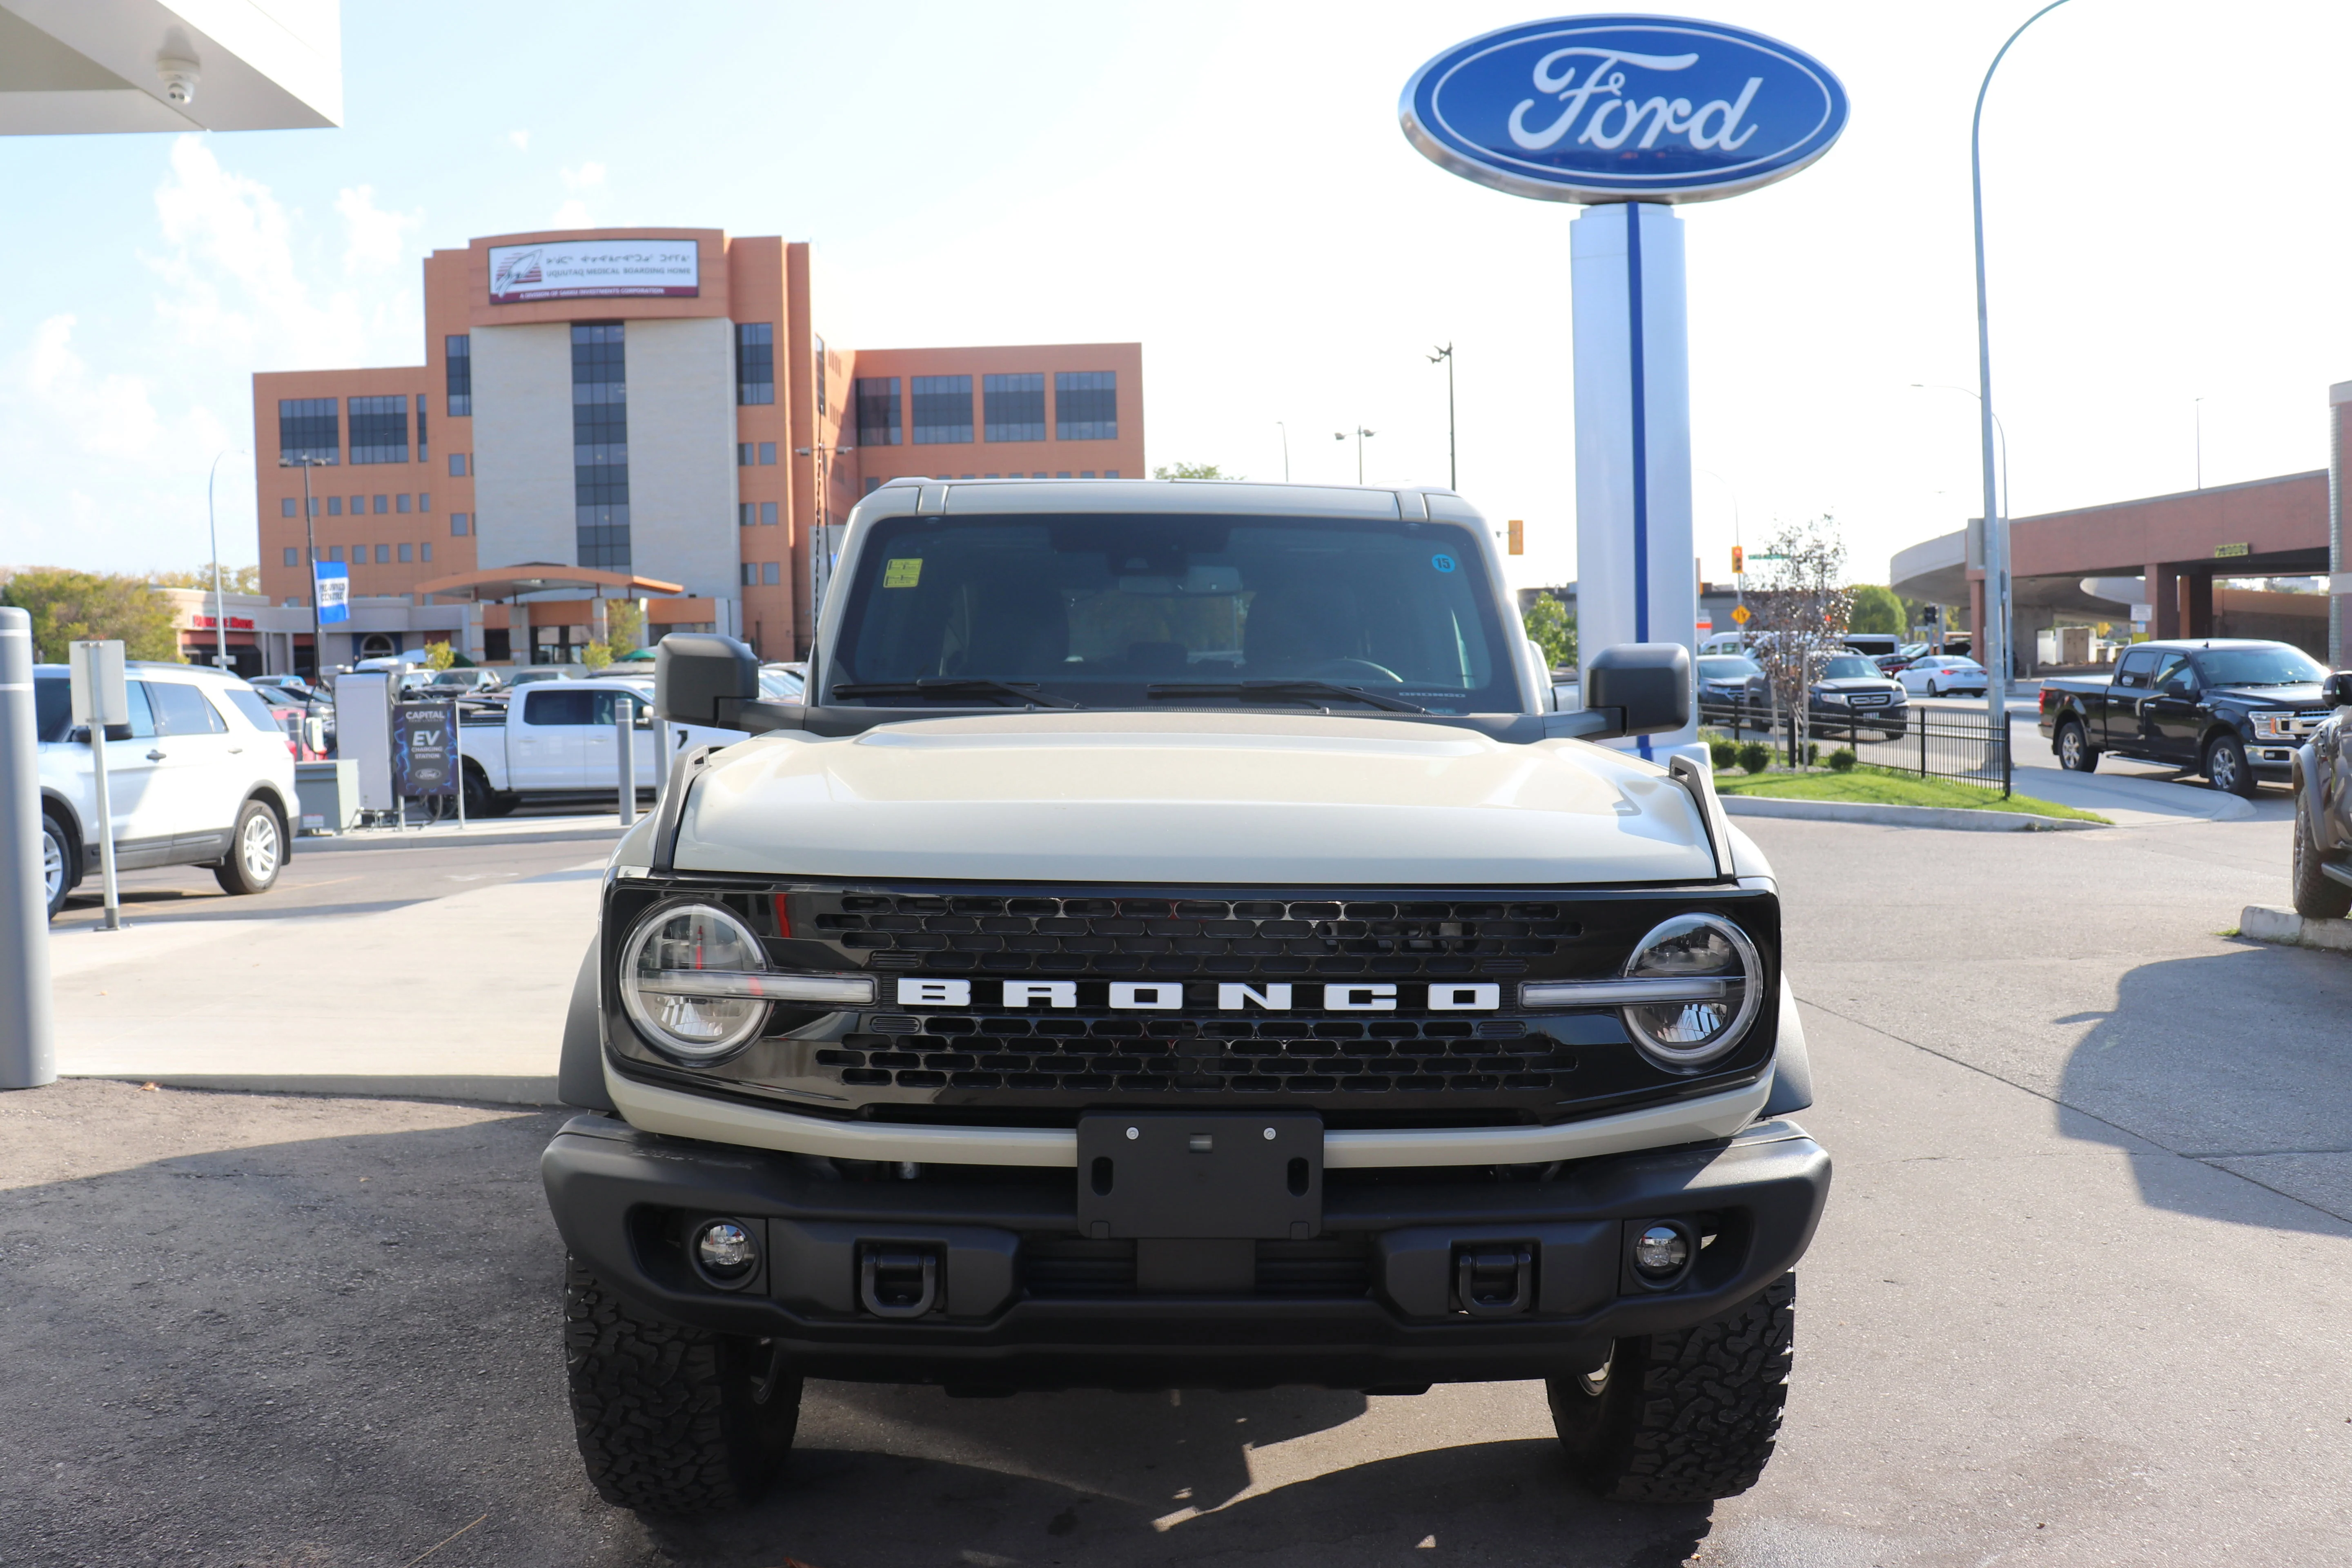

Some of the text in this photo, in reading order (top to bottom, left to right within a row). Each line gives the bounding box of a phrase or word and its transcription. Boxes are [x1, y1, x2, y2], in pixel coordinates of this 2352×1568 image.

[1508, 46, 1764, 151] Ford
[546, 268, 584, 278] UQUUTAQ
[1435, 557, 1451, 569] 15
[405, 710, 445, 720] CAPITAL
[412, 730, 441, 746] EV
[897, 977, 1501, 1011] BRONCO
